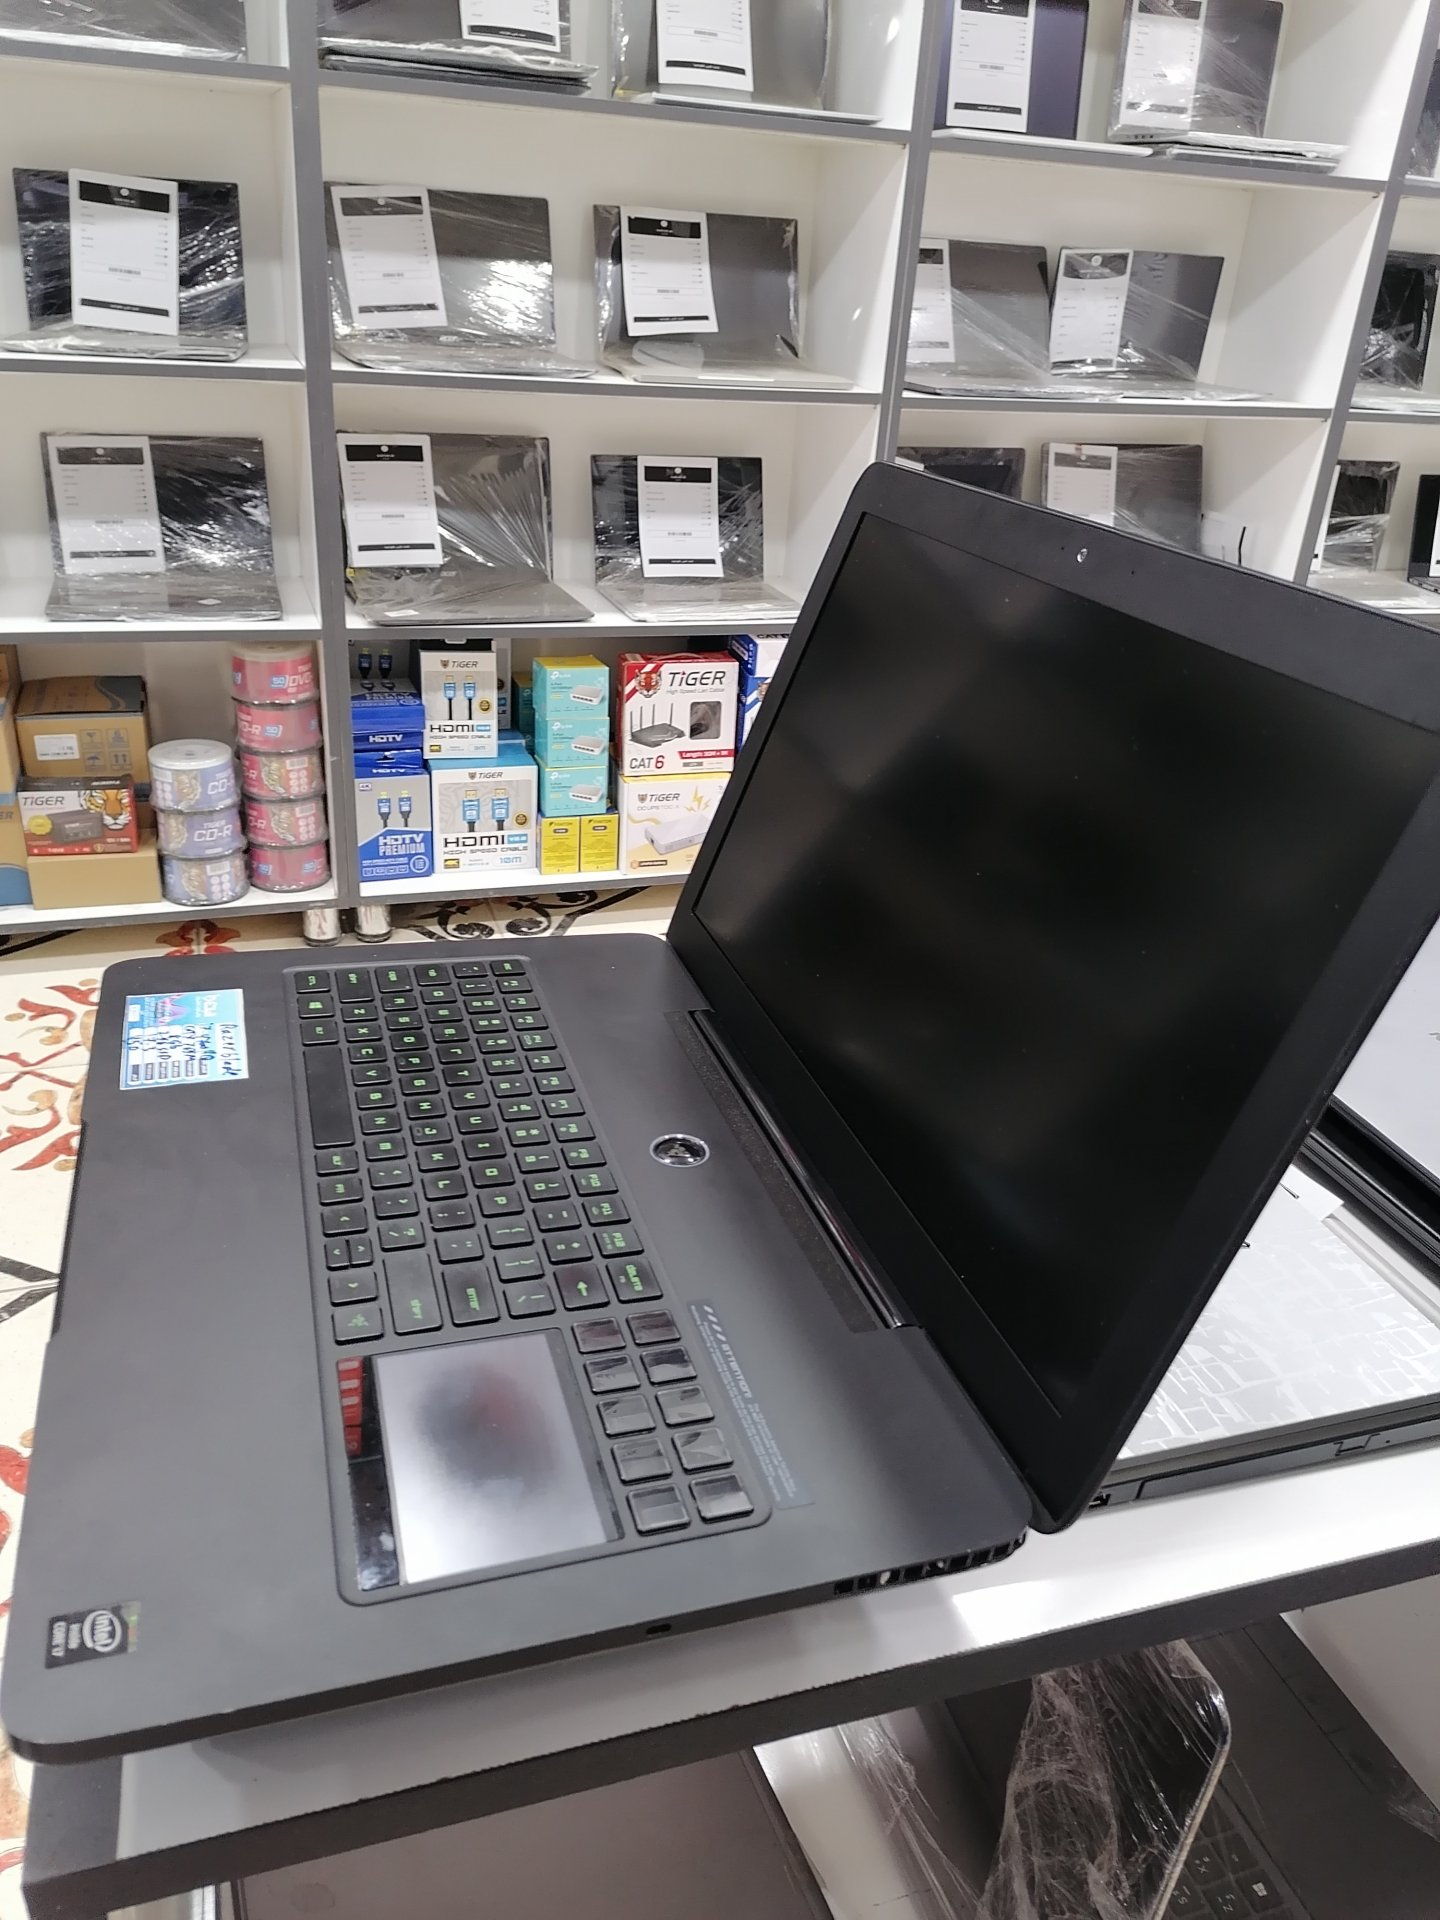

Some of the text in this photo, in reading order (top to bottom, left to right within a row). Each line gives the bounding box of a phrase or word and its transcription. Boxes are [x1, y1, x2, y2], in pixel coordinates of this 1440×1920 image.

[369, 734, 404, 743] HDTV
[630, 755, 665, 769] CAT 6
[193, 824, 232, 842] CD-R
[378, 833, 424, 845] HDTV
[379, 842, 425, 856] PREMIUM
[431, 1153, 444, 1161] K
[437, 1180, 451, 1189] L
[494, 1196, 507, 1205] P
